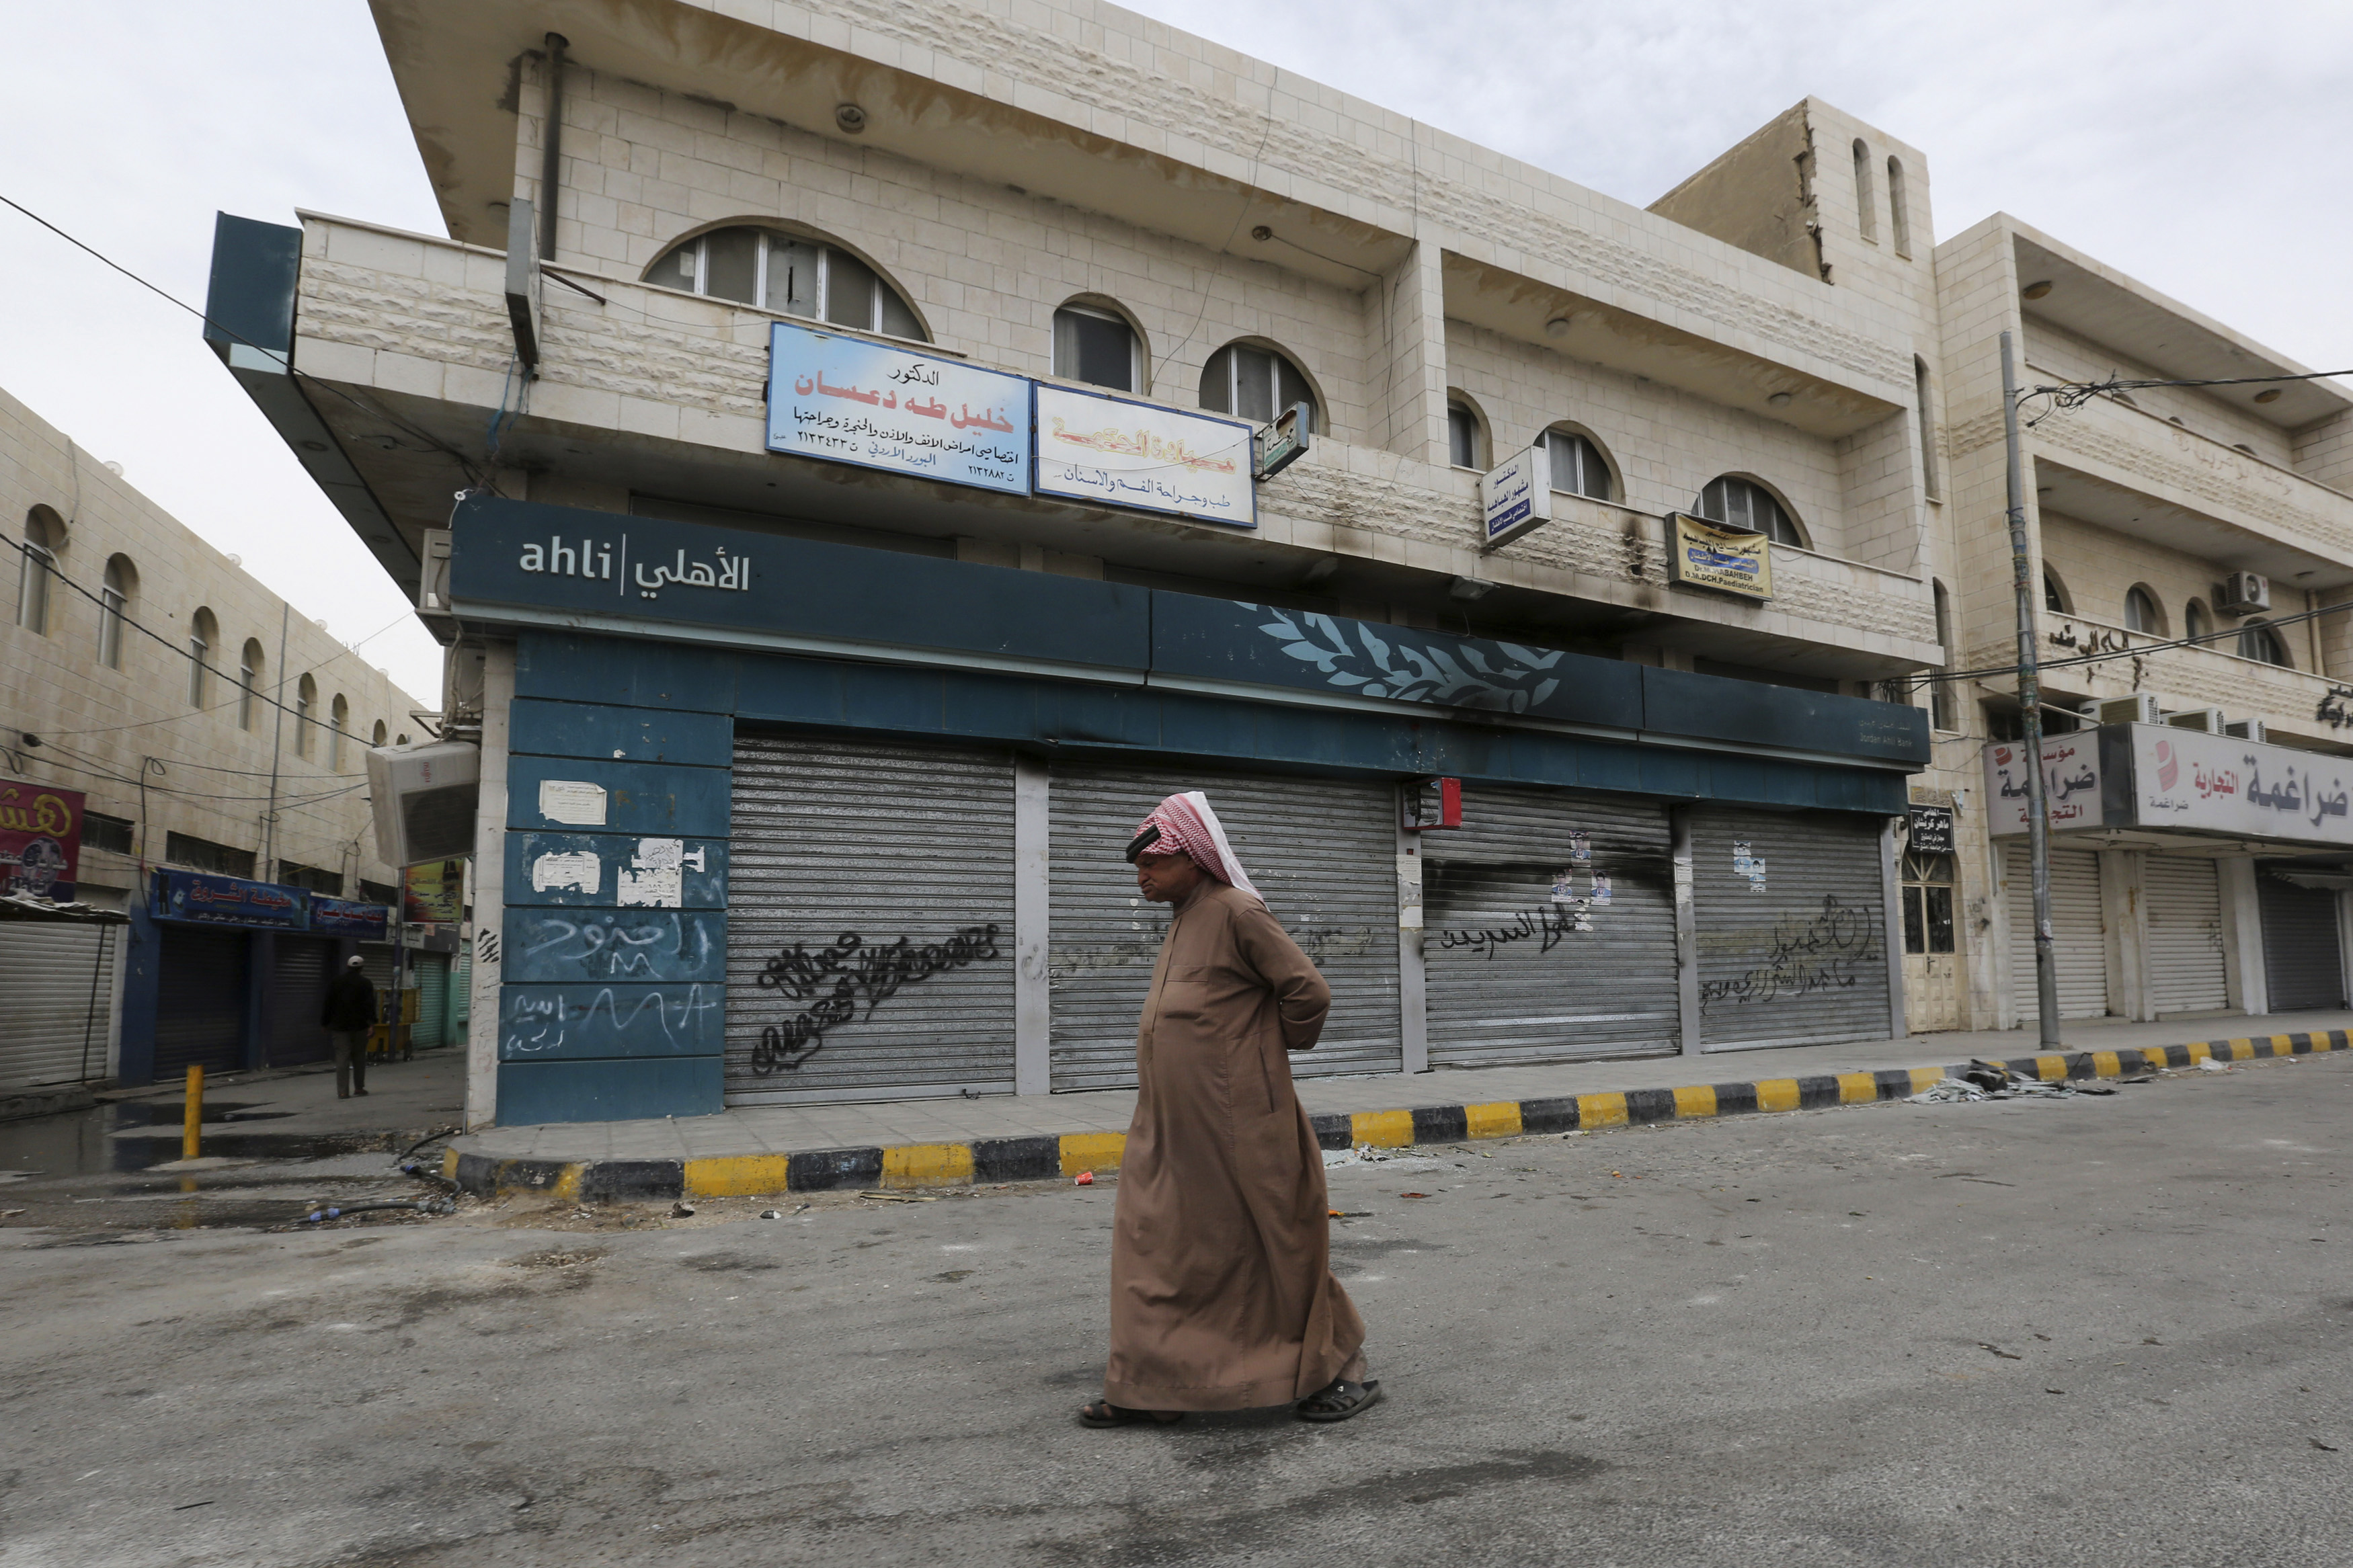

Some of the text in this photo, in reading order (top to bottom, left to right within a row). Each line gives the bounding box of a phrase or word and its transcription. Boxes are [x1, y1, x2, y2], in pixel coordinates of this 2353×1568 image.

[887, 364, 939, 386] الدكتور
[795, 370, 1014, 436] خليل طه دعسان
[794, 406, 840, 428] وجراحتها
[915, 434, 943, 448] الانف
[943, 440, 975, 454] امراض
[1052, 416, 1150, 458] الحكمة
[906, 452, 936, 466] البورد
[1150, 436, 1236, 474] عيادة
[1064, 464, 1231, 509] طب وجراحة الفم والاسنان
[1494, 463, 1519, 490] الدكتور
[1511, 479, 1529, 501] مشهور
[520, 536, 750, 599] ahli الأهلي
[2020, 745, 2075, 763] مؤسة
[1997, 764, 2096, 800] ضرامة
[2193, 754, 2348, 827] ضراغمة التجارية
[191, 880, 247, 903] الشروق
